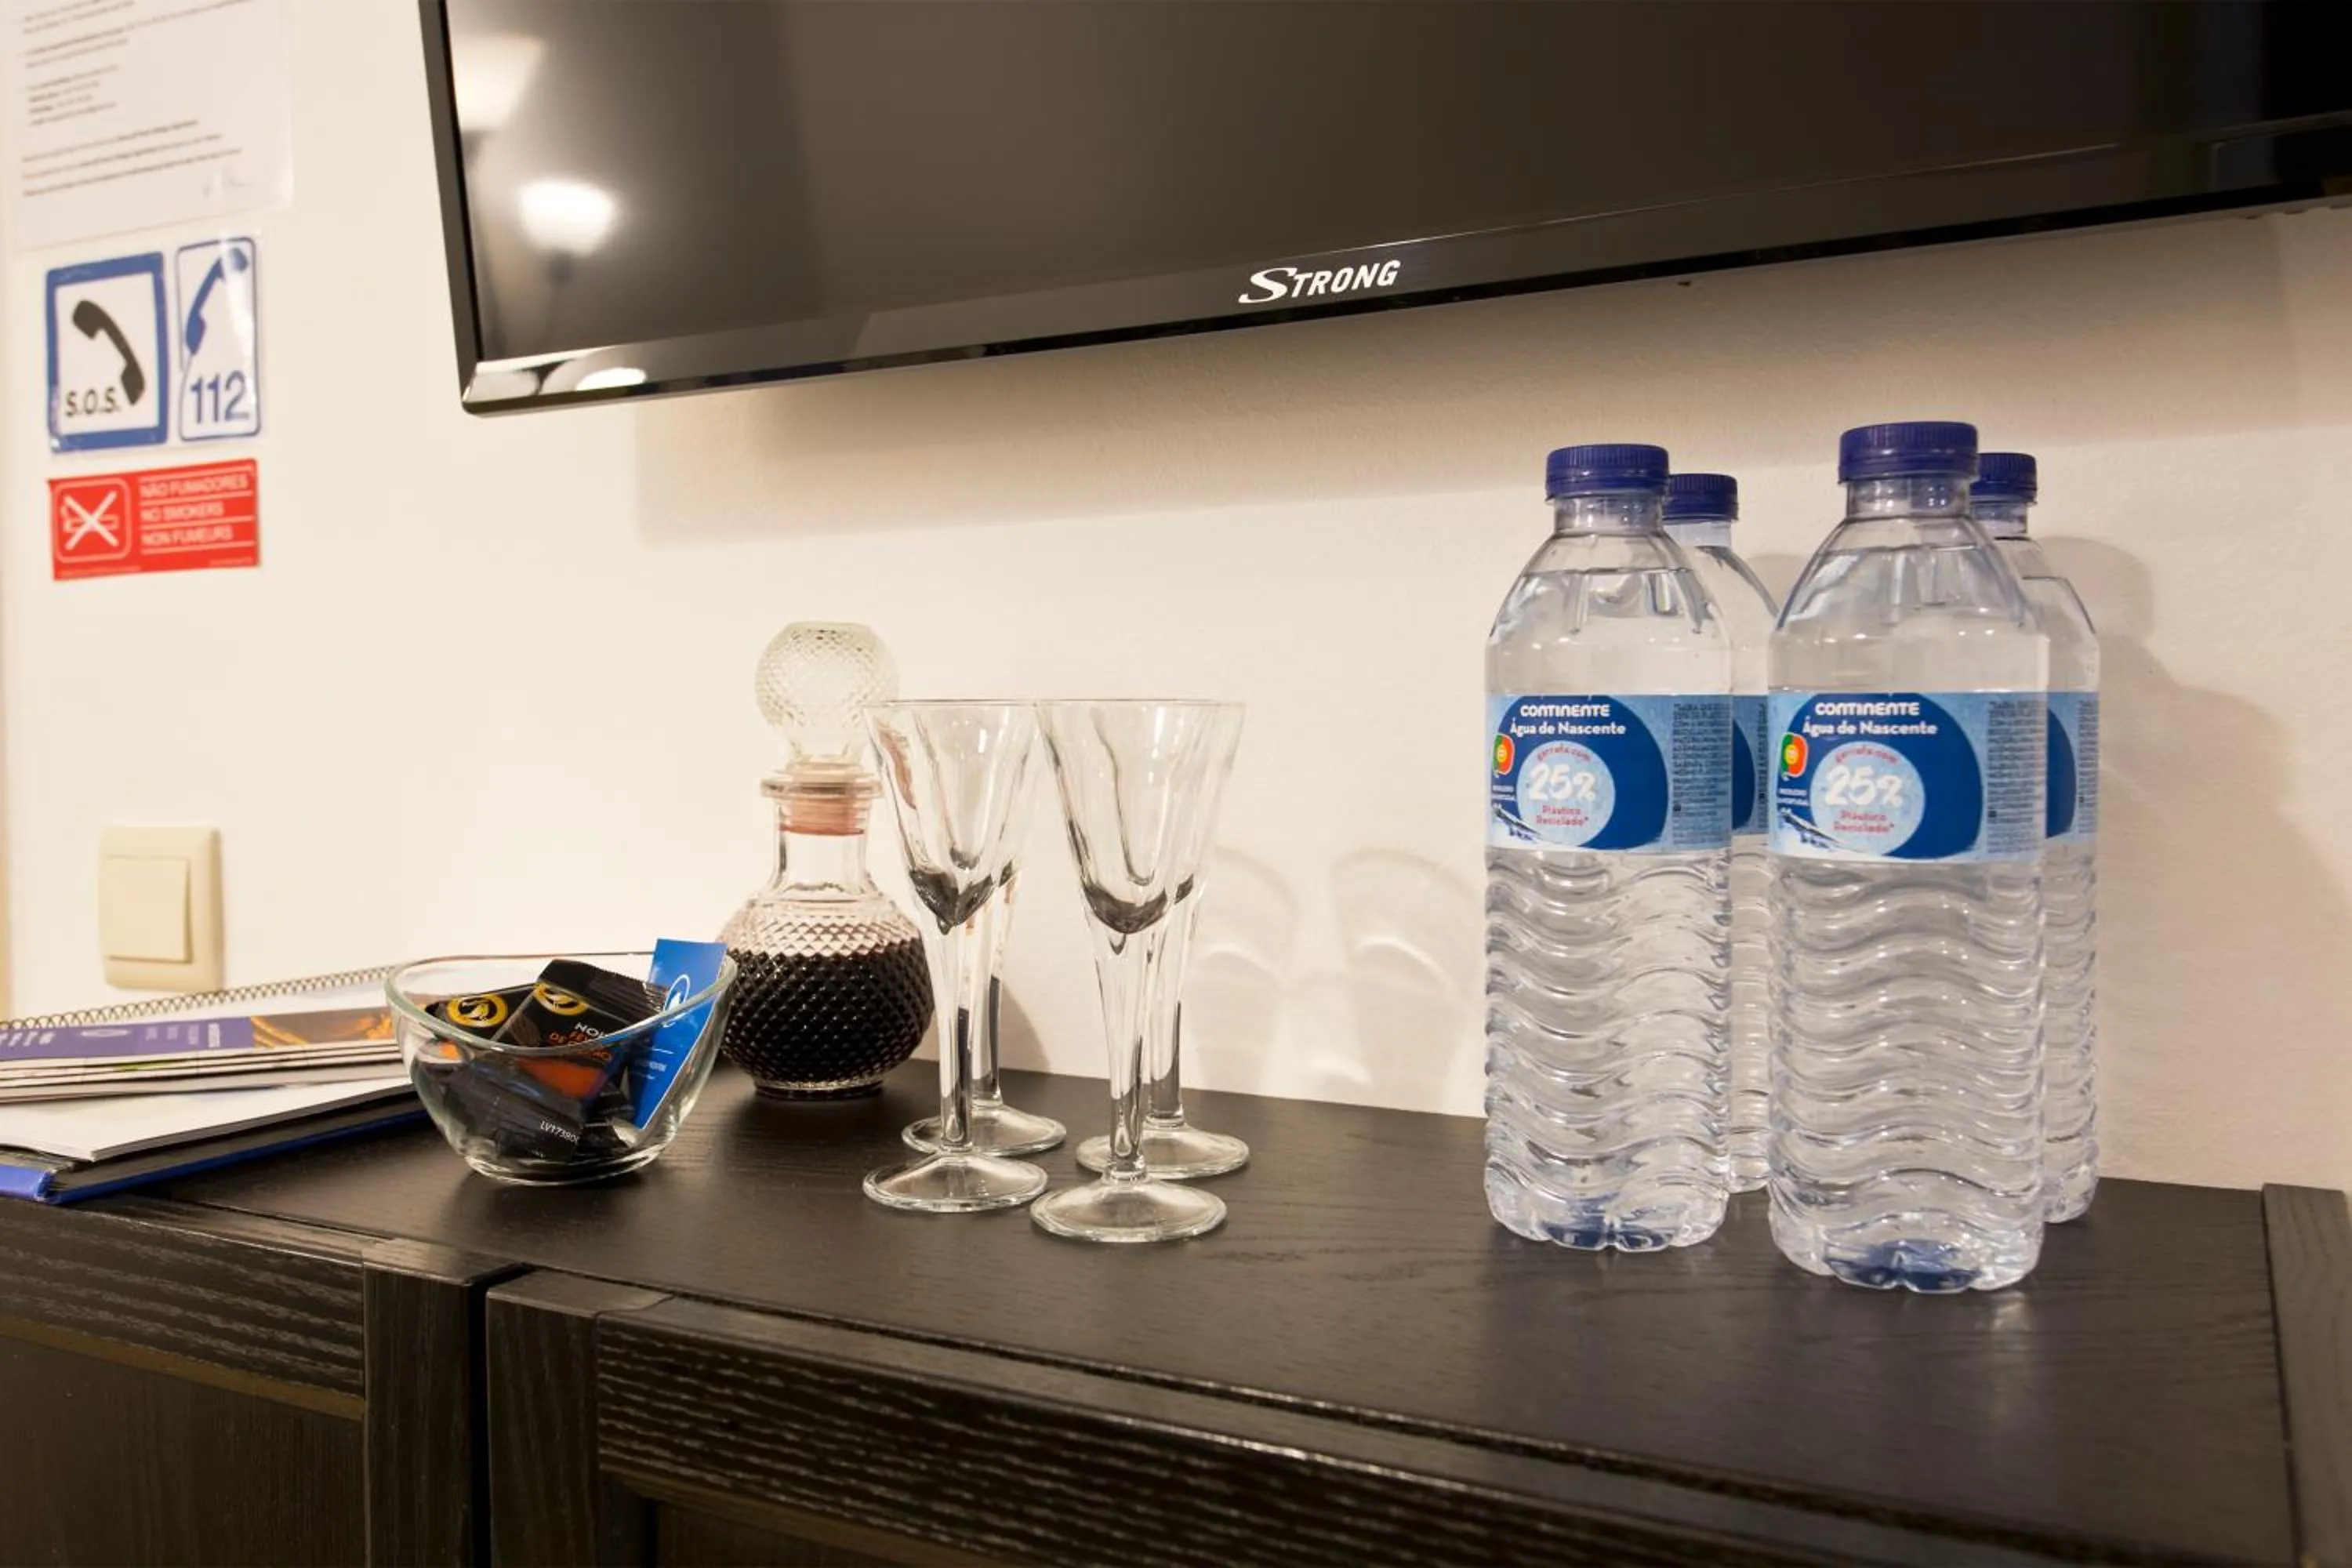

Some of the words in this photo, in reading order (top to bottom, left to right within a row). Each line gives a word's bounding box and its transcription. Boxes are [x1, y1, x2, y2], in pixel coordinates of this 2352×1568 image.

[1239, 260, 1400, 303] STRONG
[64, 387, 121, 417] S.O.S.
[191, 370, 250, 423] 112
[141, 507, 161, 522] NO
[162, 501, 224, 521] SMOKERS
[141, 530, 170, 546] NON
[1520, 704, 1610, 717] CONTINENTE
[1815, 702, 1920, 716] CONTINENTE
[1510, 717, 1537, 737] Água
[1538, 721, 1555, 735] de
[1558, 722, 1627, 735] Nascente
[1802, 715, 1835, 737] Água
[1837, 720, 1857, 735] de
[1860, 720, 1938, 735] Nascente
[1529, 762, 1596, 801] 25%
[1825, 765, 1903, 808] 25%
